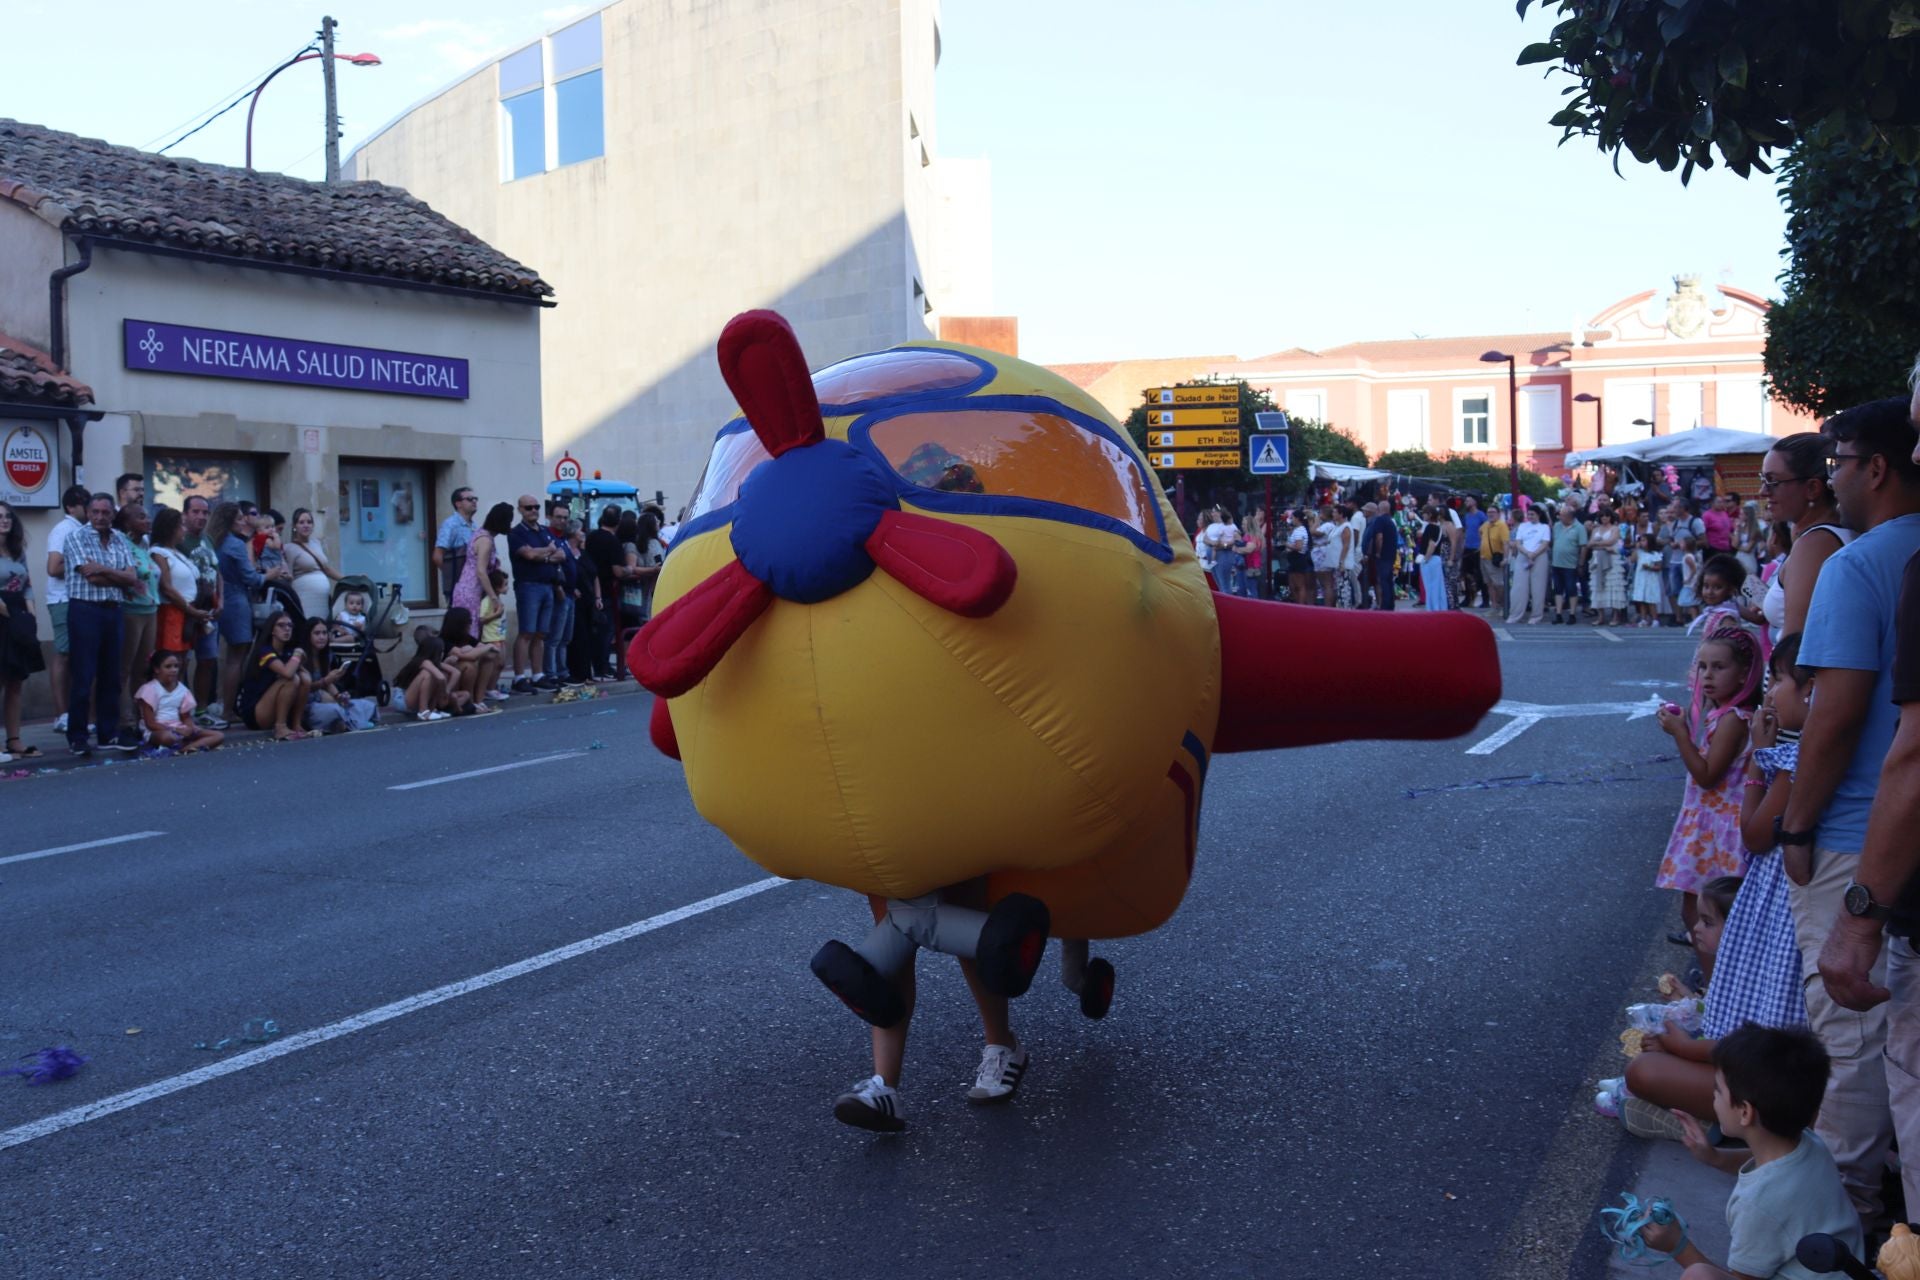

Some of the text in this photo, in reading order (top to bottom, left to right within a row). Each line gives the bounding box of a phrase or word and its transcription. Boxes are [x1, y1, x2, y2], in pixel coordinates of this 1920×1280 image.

[183, 336, 459, 389] NEREAMA SALUD INTEGRAL
[1218, 393, 1237, 401] Haro
[1218, 436, 1238, 445] Rioja
[10, 448, 43, 460] AMSTEL
[1196, 458, 1238, 466] Peregrinos
[13, 464, 40, 472] CERVEZA
[561, 467, 576, 476] 30
